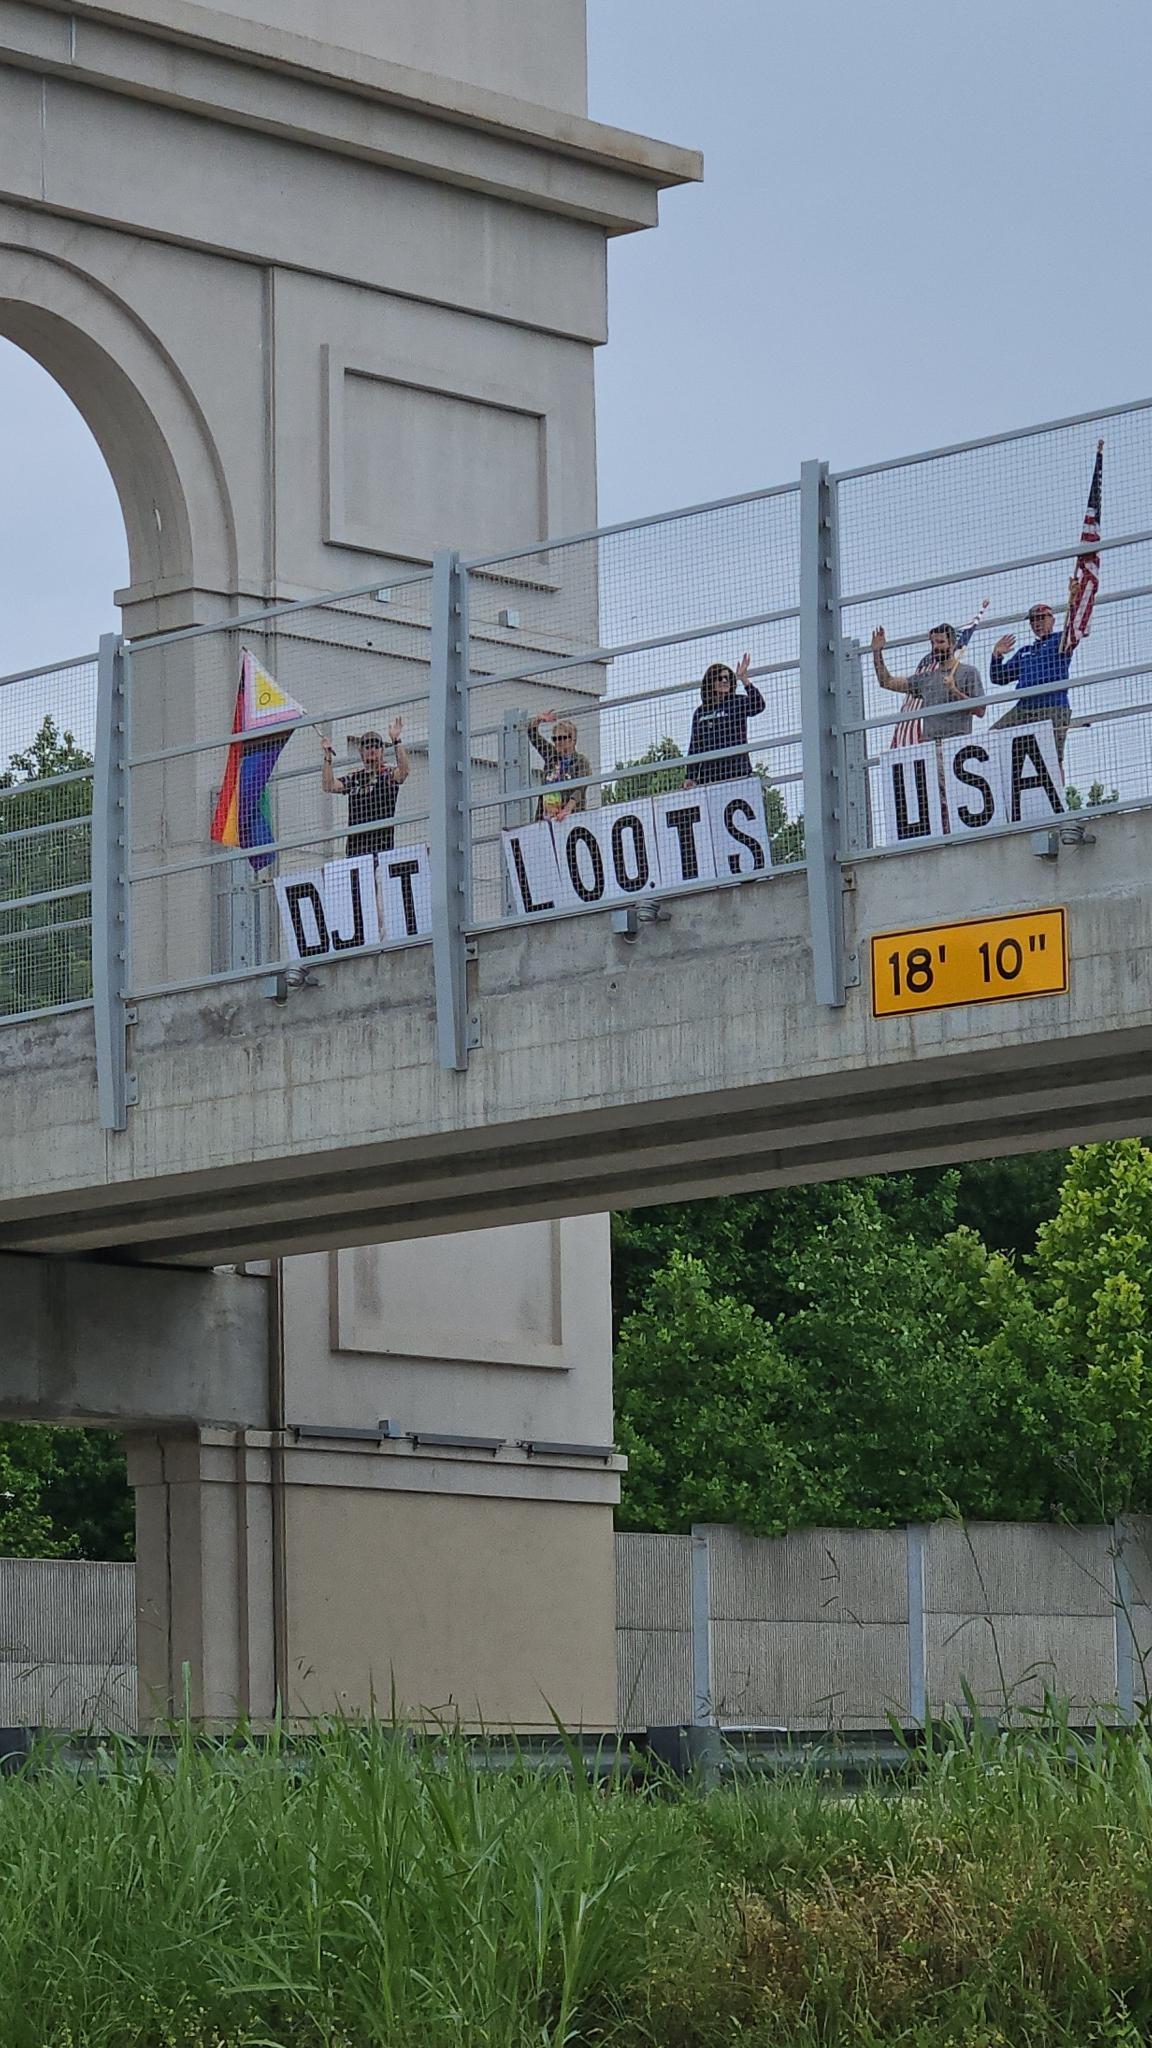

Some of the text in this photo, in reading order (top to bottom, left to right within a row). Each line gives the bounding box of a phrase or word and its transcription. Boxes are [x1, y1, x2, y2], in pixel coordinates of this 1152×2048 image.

[285, 859, 420, 958] DJT
[891, 733, 1066, 840] USA
[888, 933, 1046, 996] 18' 10"
